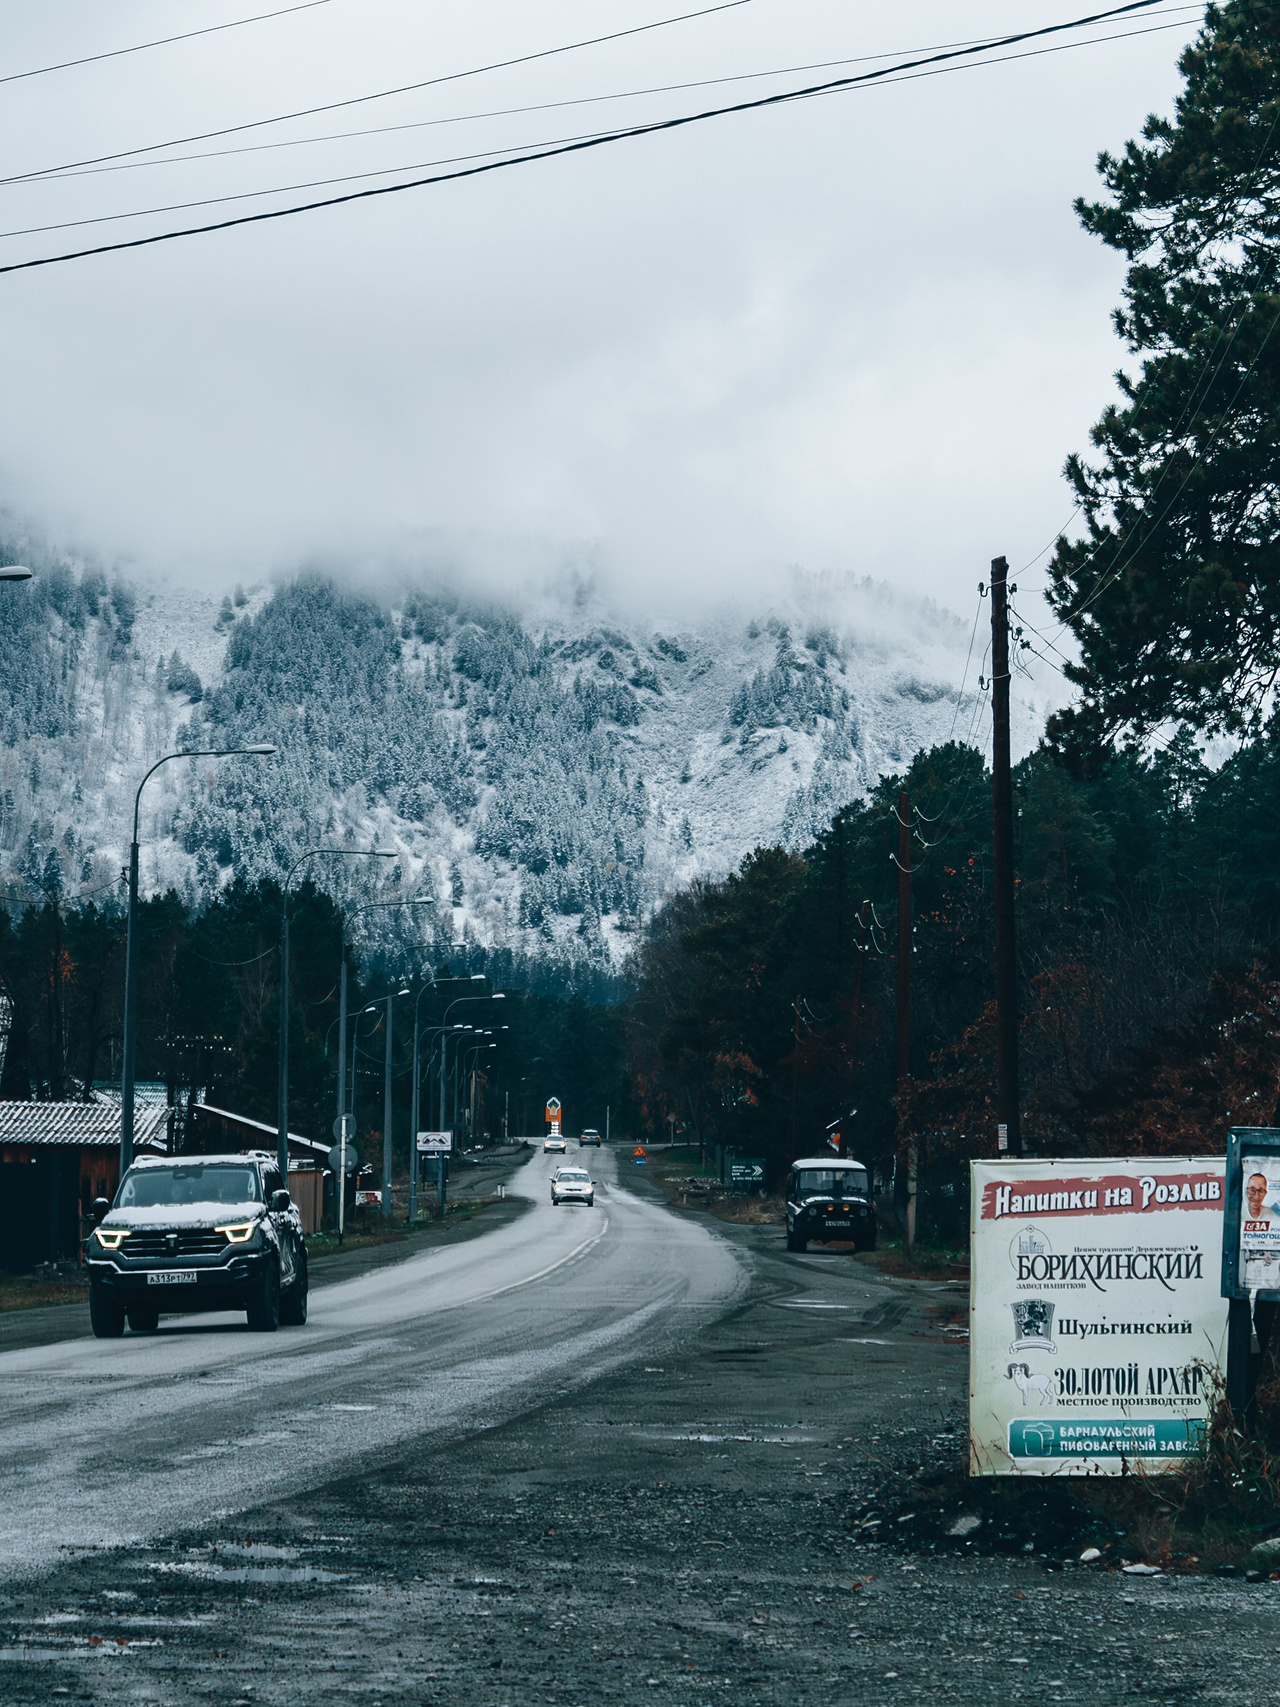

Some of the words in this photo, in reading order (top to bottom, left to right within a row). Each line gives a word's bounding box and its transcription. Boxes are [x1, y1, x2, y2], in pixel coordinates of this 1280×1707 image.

[995, 1186, 1098, 1219] Напитки
[1104, 1187, 1133, 1207] на
[1139, 1176, 1221, 1210] Розлив
[1016, 1245, 1203, 1292] БОРИХИНСКИЙ
[1044, 1282, 1087, 1290] НАПИТКОВ
[1058, 1319, 1193, 1340] Шульгинский
[1054, 1362, 1140, 1396] ЗОЛОТОЙ
[1145, 1367, 1204, 1396] АРХАР
[1056, 1398, 1109, 1406] местное
[1111, 1397, 1201, 1407] производство
[1059, 1425, 1156, 1438] БАРНАУЛЬСКИЙ
